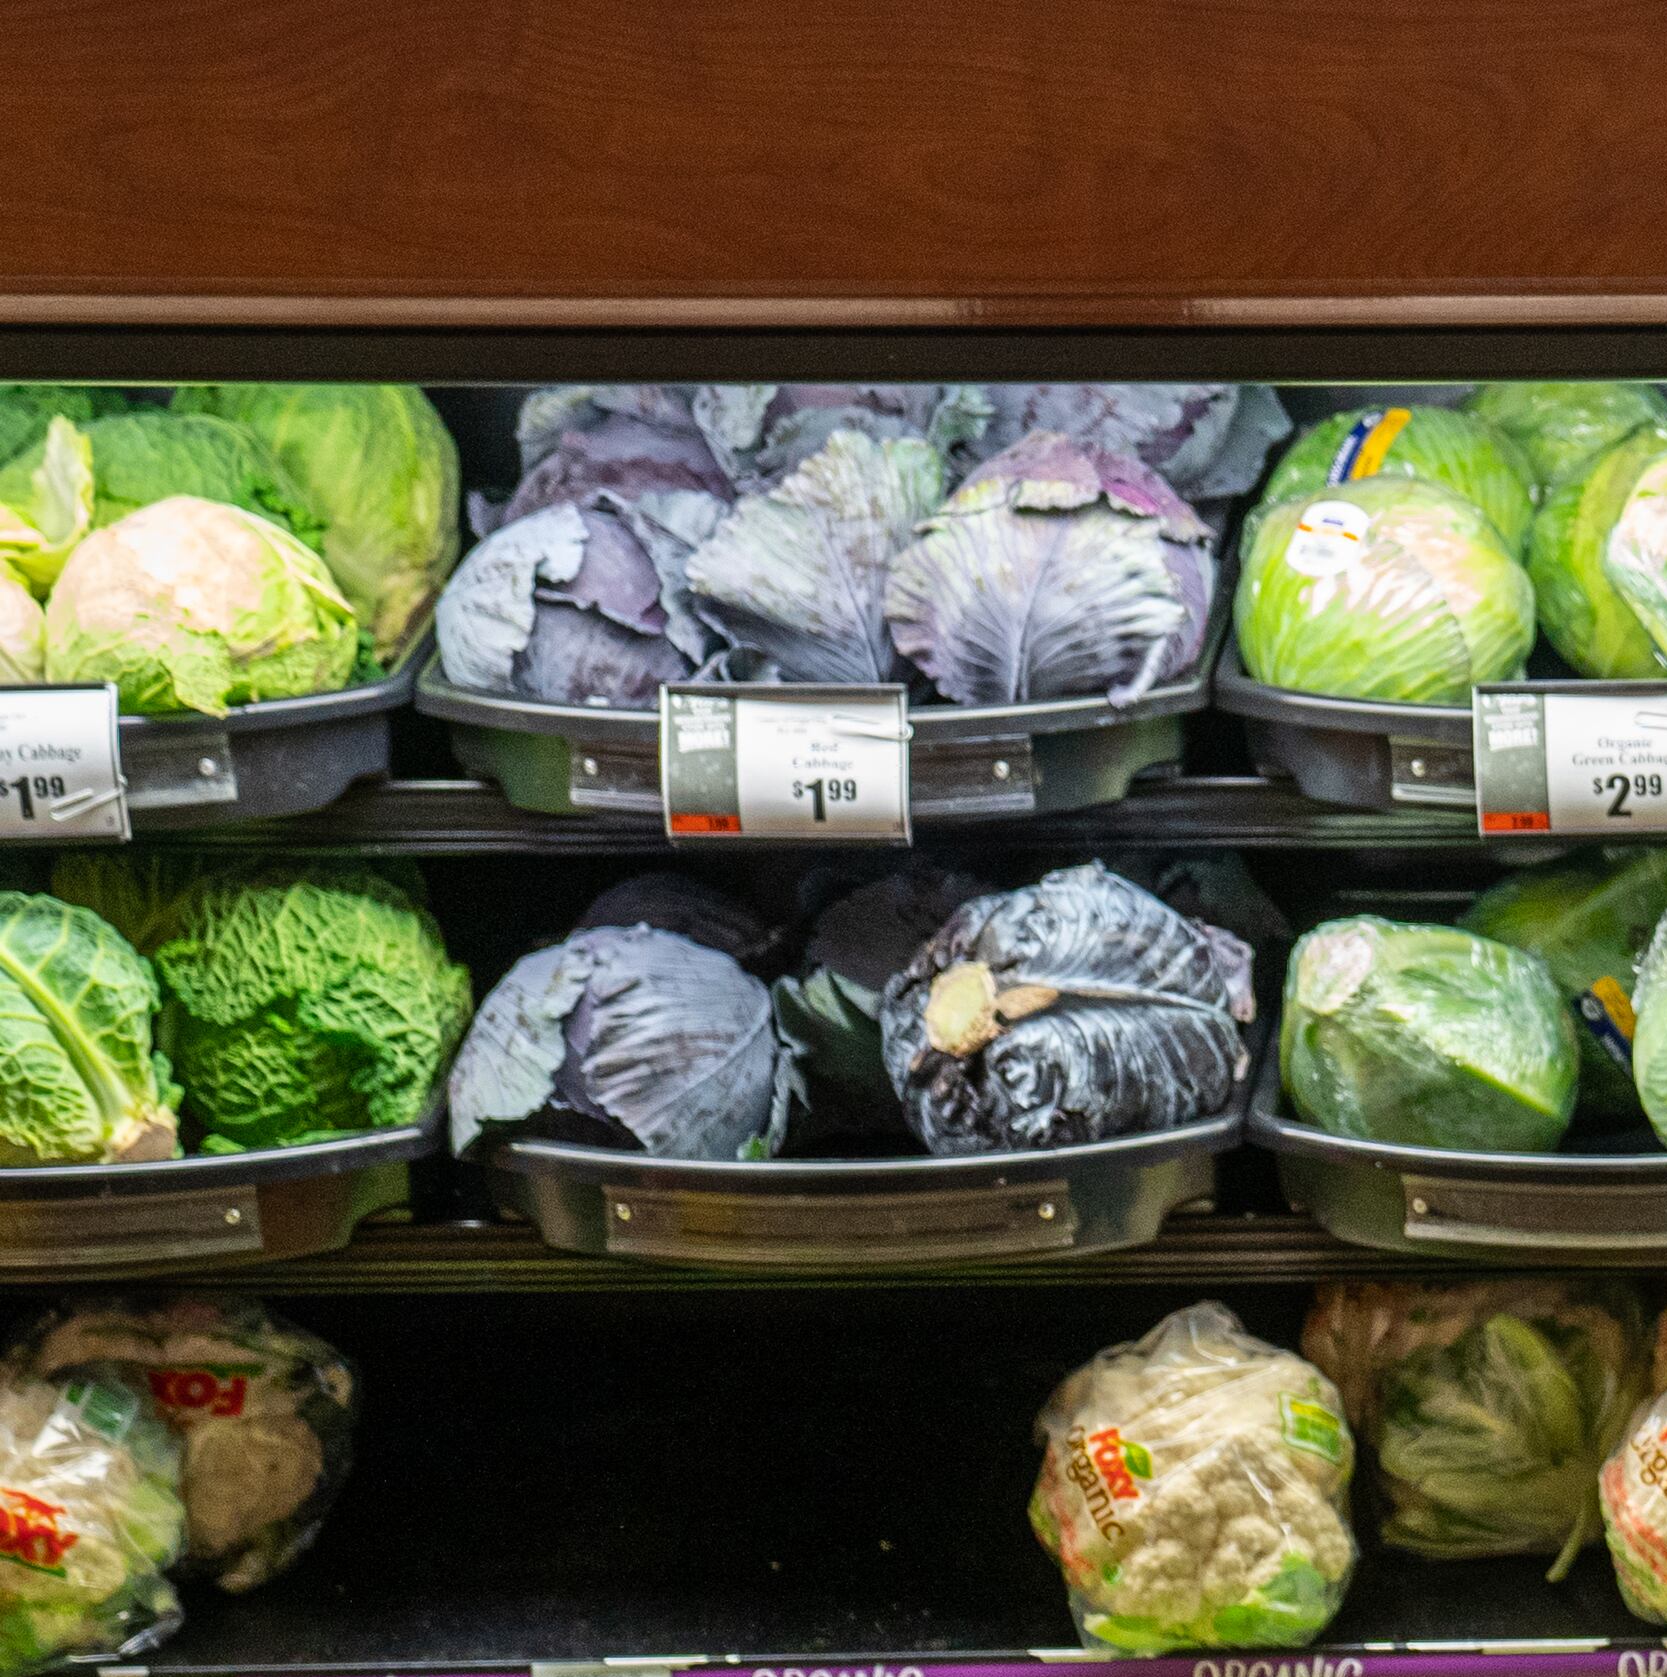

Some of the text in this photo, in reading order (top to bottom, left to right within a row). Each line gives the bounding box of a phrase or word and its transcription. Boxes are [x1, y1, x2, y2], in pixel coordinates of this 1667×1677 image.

[1597, 737, 1653, 751] Organic
[18, 743, 82, 763] Cabbage
[1572, 753, 1614, 766] Green
[792, 757, 854, 770] Cabbage
